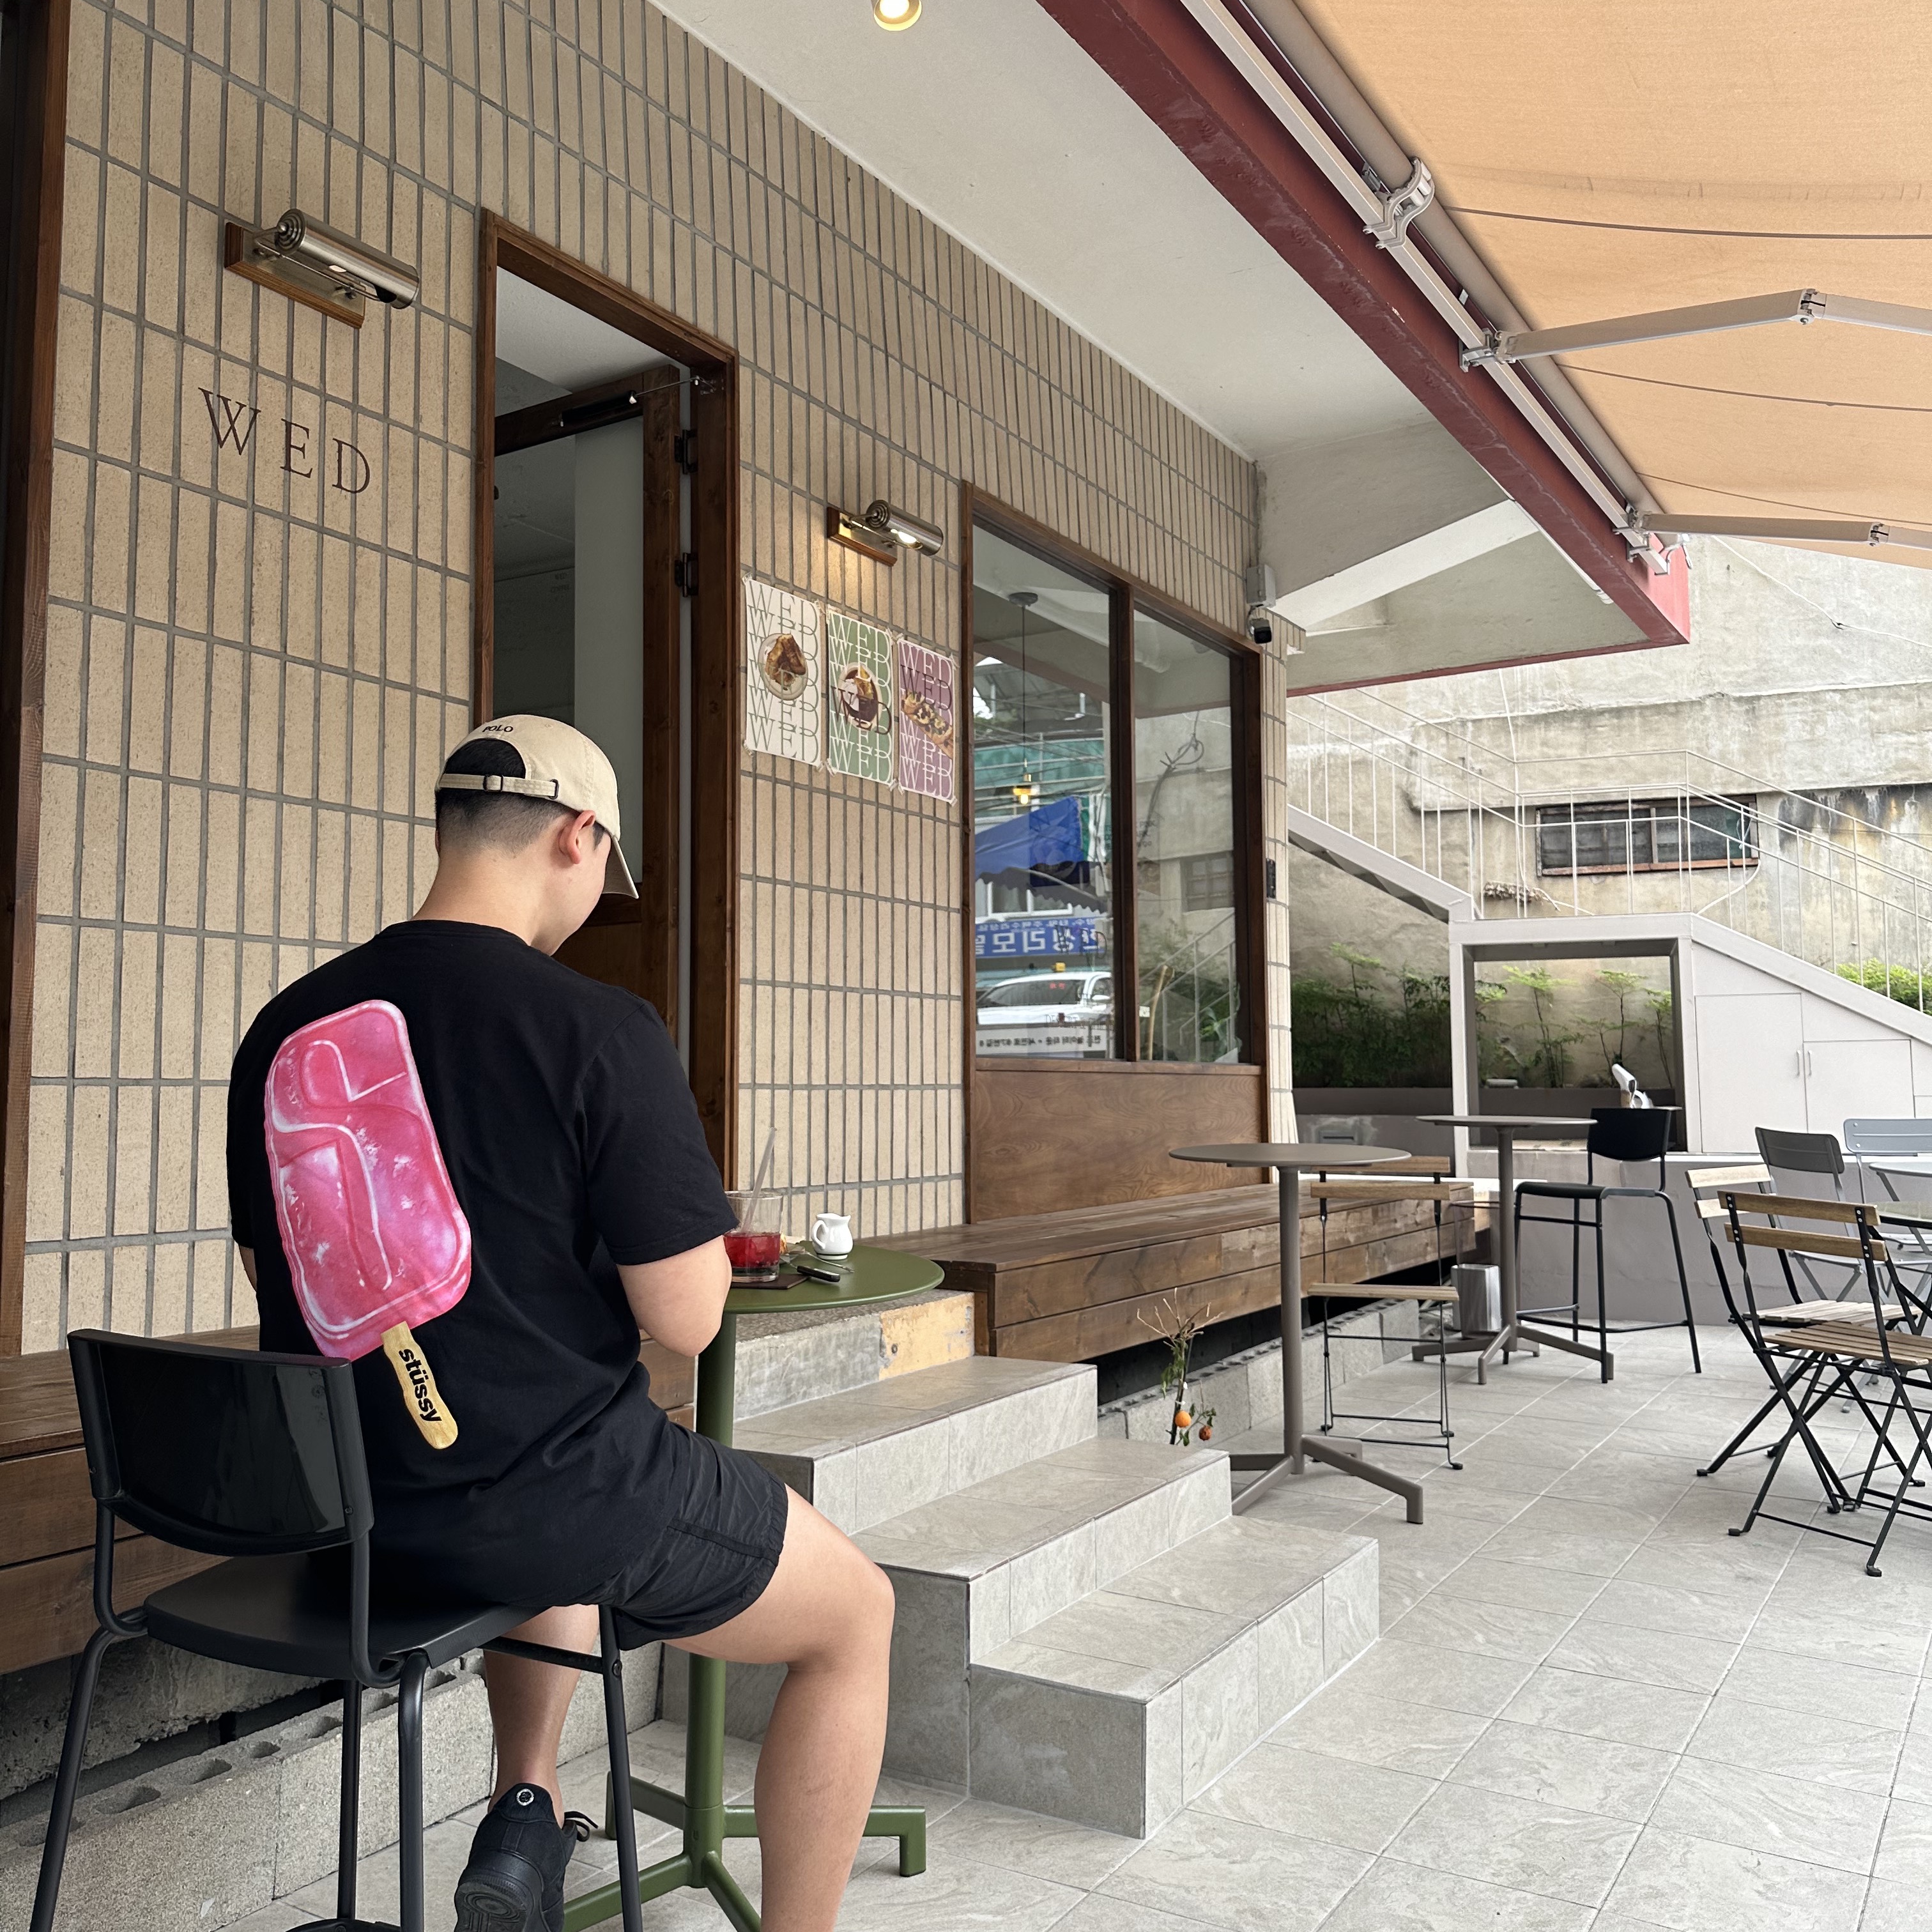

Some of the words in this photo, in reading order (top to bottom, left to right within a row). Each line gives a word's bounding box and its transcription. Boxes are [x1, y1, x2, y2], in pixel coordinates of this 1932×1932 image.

[197, 387, 371, 494] WED
[749, 580, 818, 635] WED
[831, 611, 891, 663] WED
[899, 641, 952, 689] WED
[900, 664, 953, 711] WED
[482, 724, 514, 733] POLO
[831, 686, 892, 735] WED
[748, 712, 820, 763] WED
[830, 736, 893, 783] WED
[900, 756, 953, 799] WED
[398, 1349, 442, 1422] stüssy
